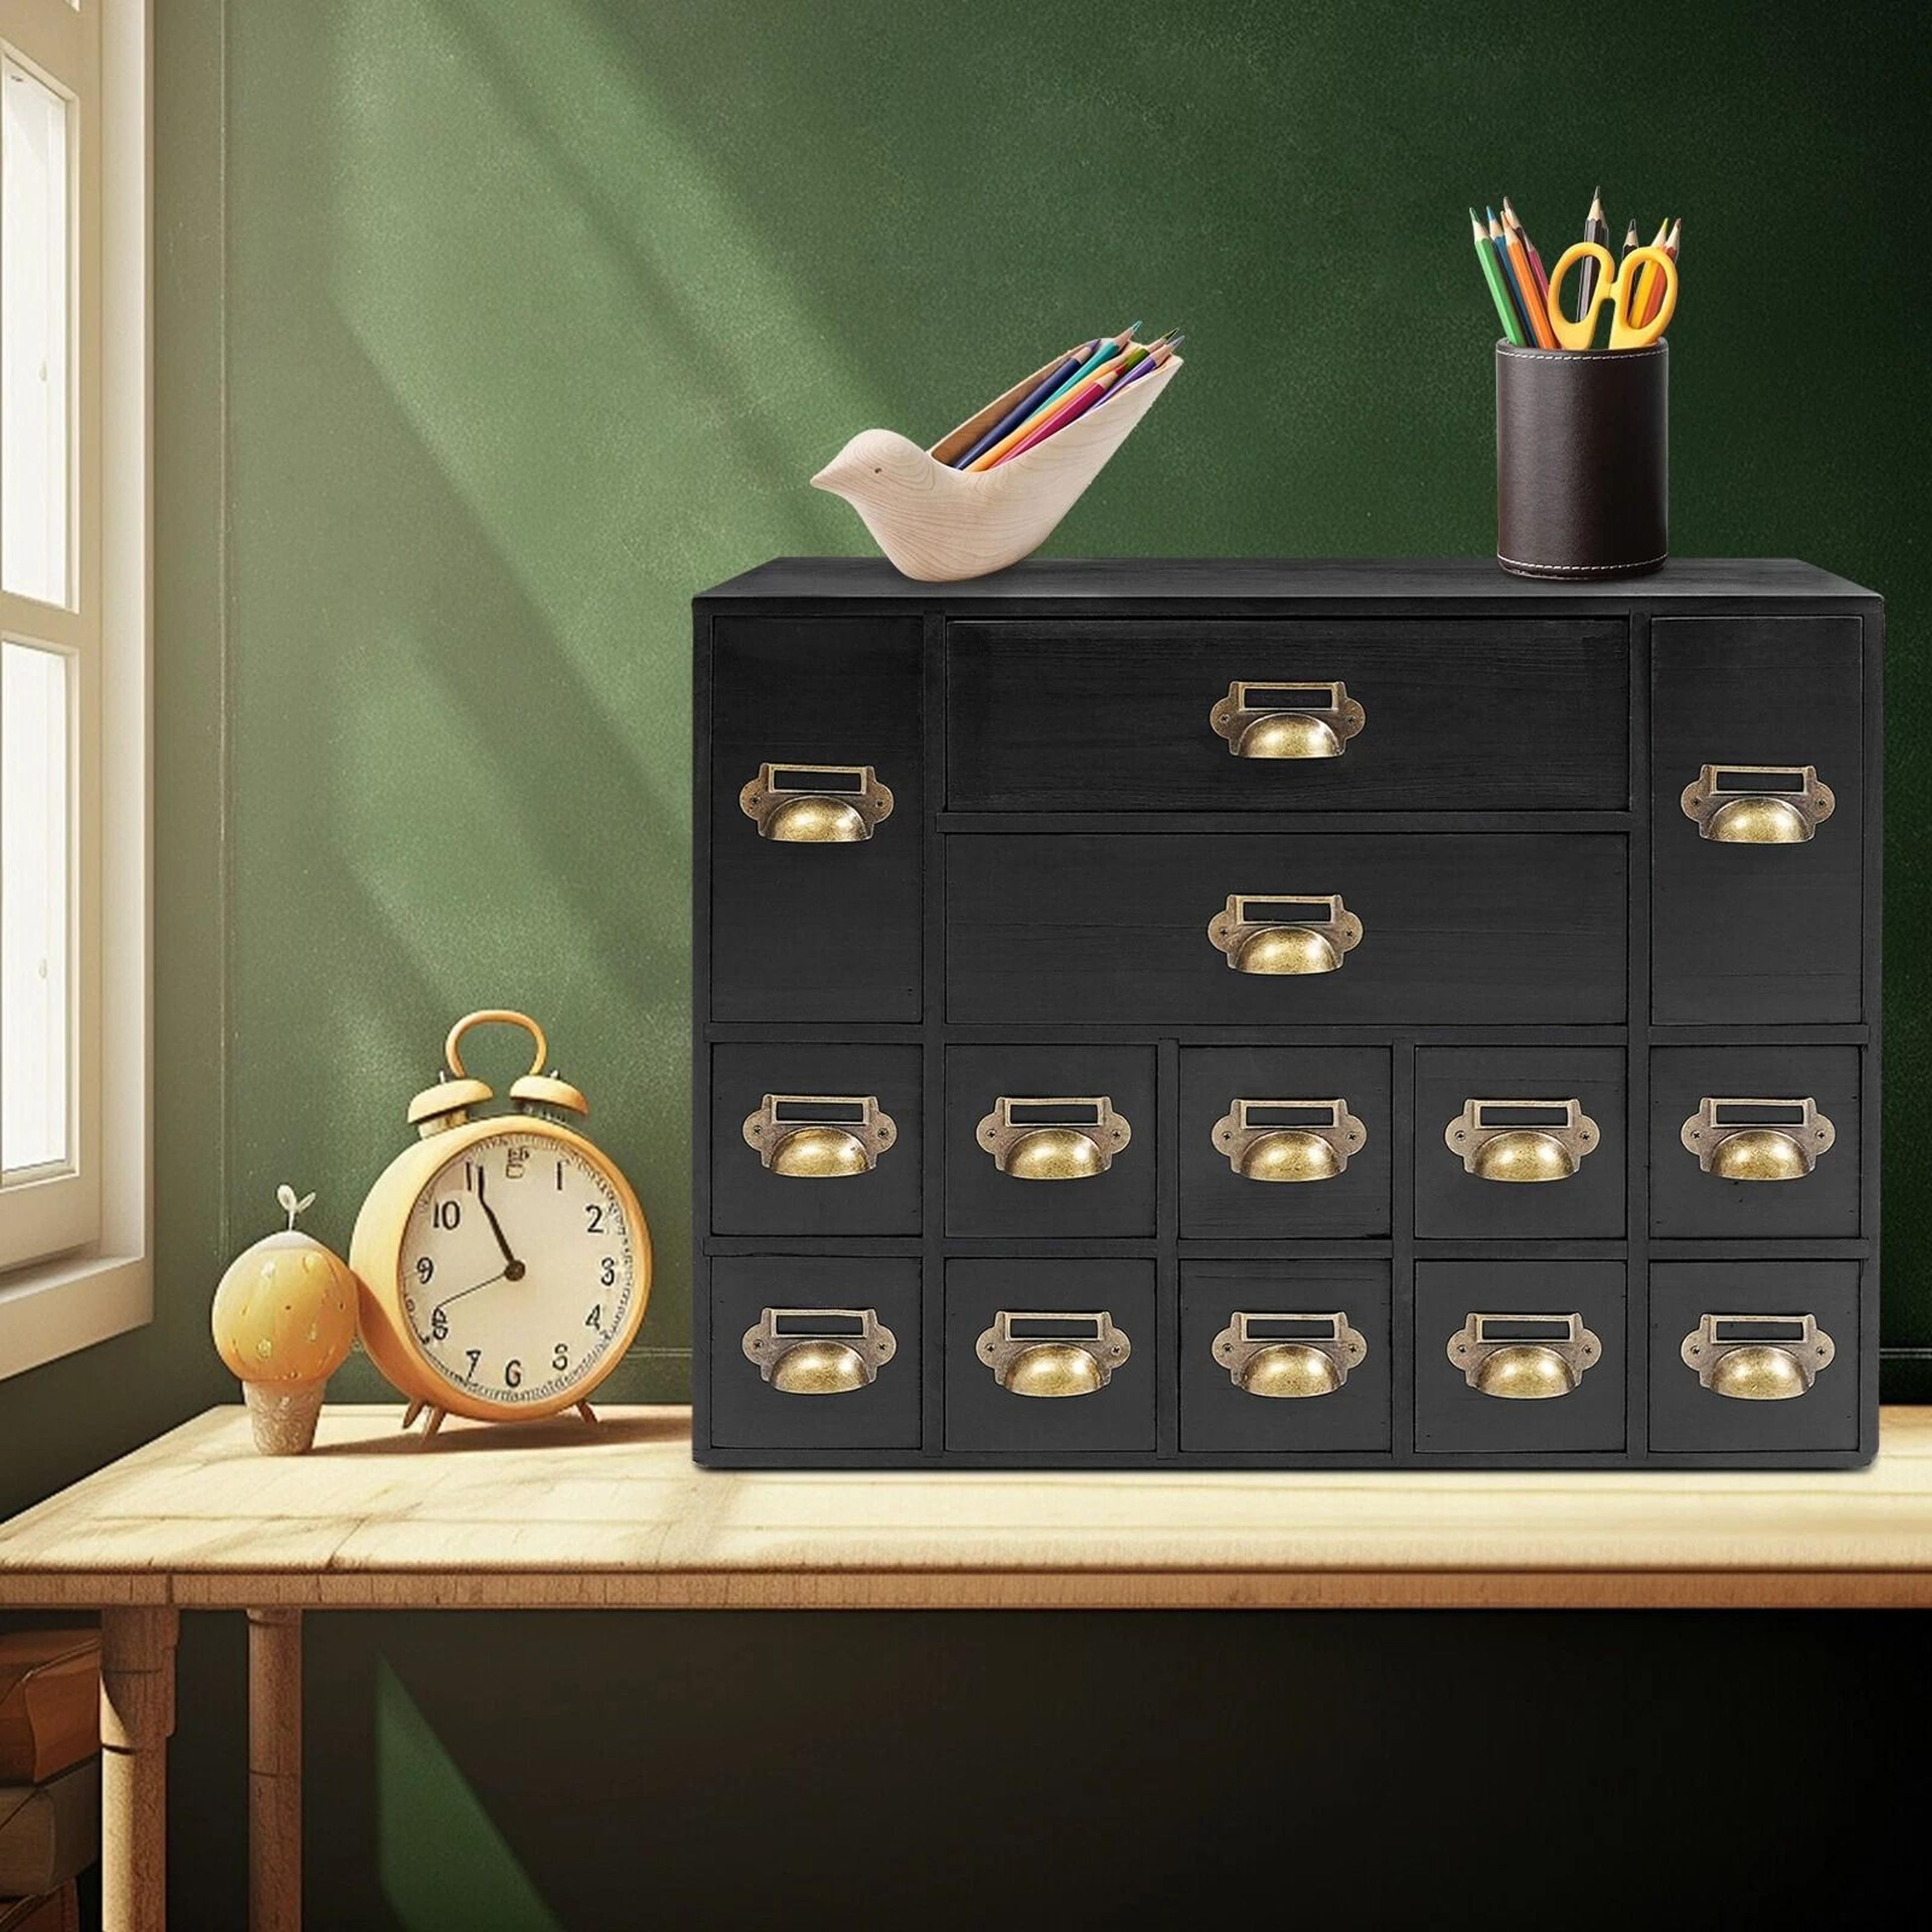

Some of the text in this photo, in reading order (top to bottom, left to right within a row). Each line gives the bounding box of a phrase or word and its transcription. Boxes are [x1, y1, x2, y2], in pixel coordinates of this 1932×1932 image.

[556, 1161, 563, 1191] 1
[433, 1200, 461, 1231] 10
[585, 1204, 604, 1233] 2
[416, 1256, 434, 1284] 9
[431, 1307, 449, 1341] 8
[585, 1304, 601, 1331] 4
[466, 1349, 481, 1382] 7
[505, 1359, 522, 1389] 6
